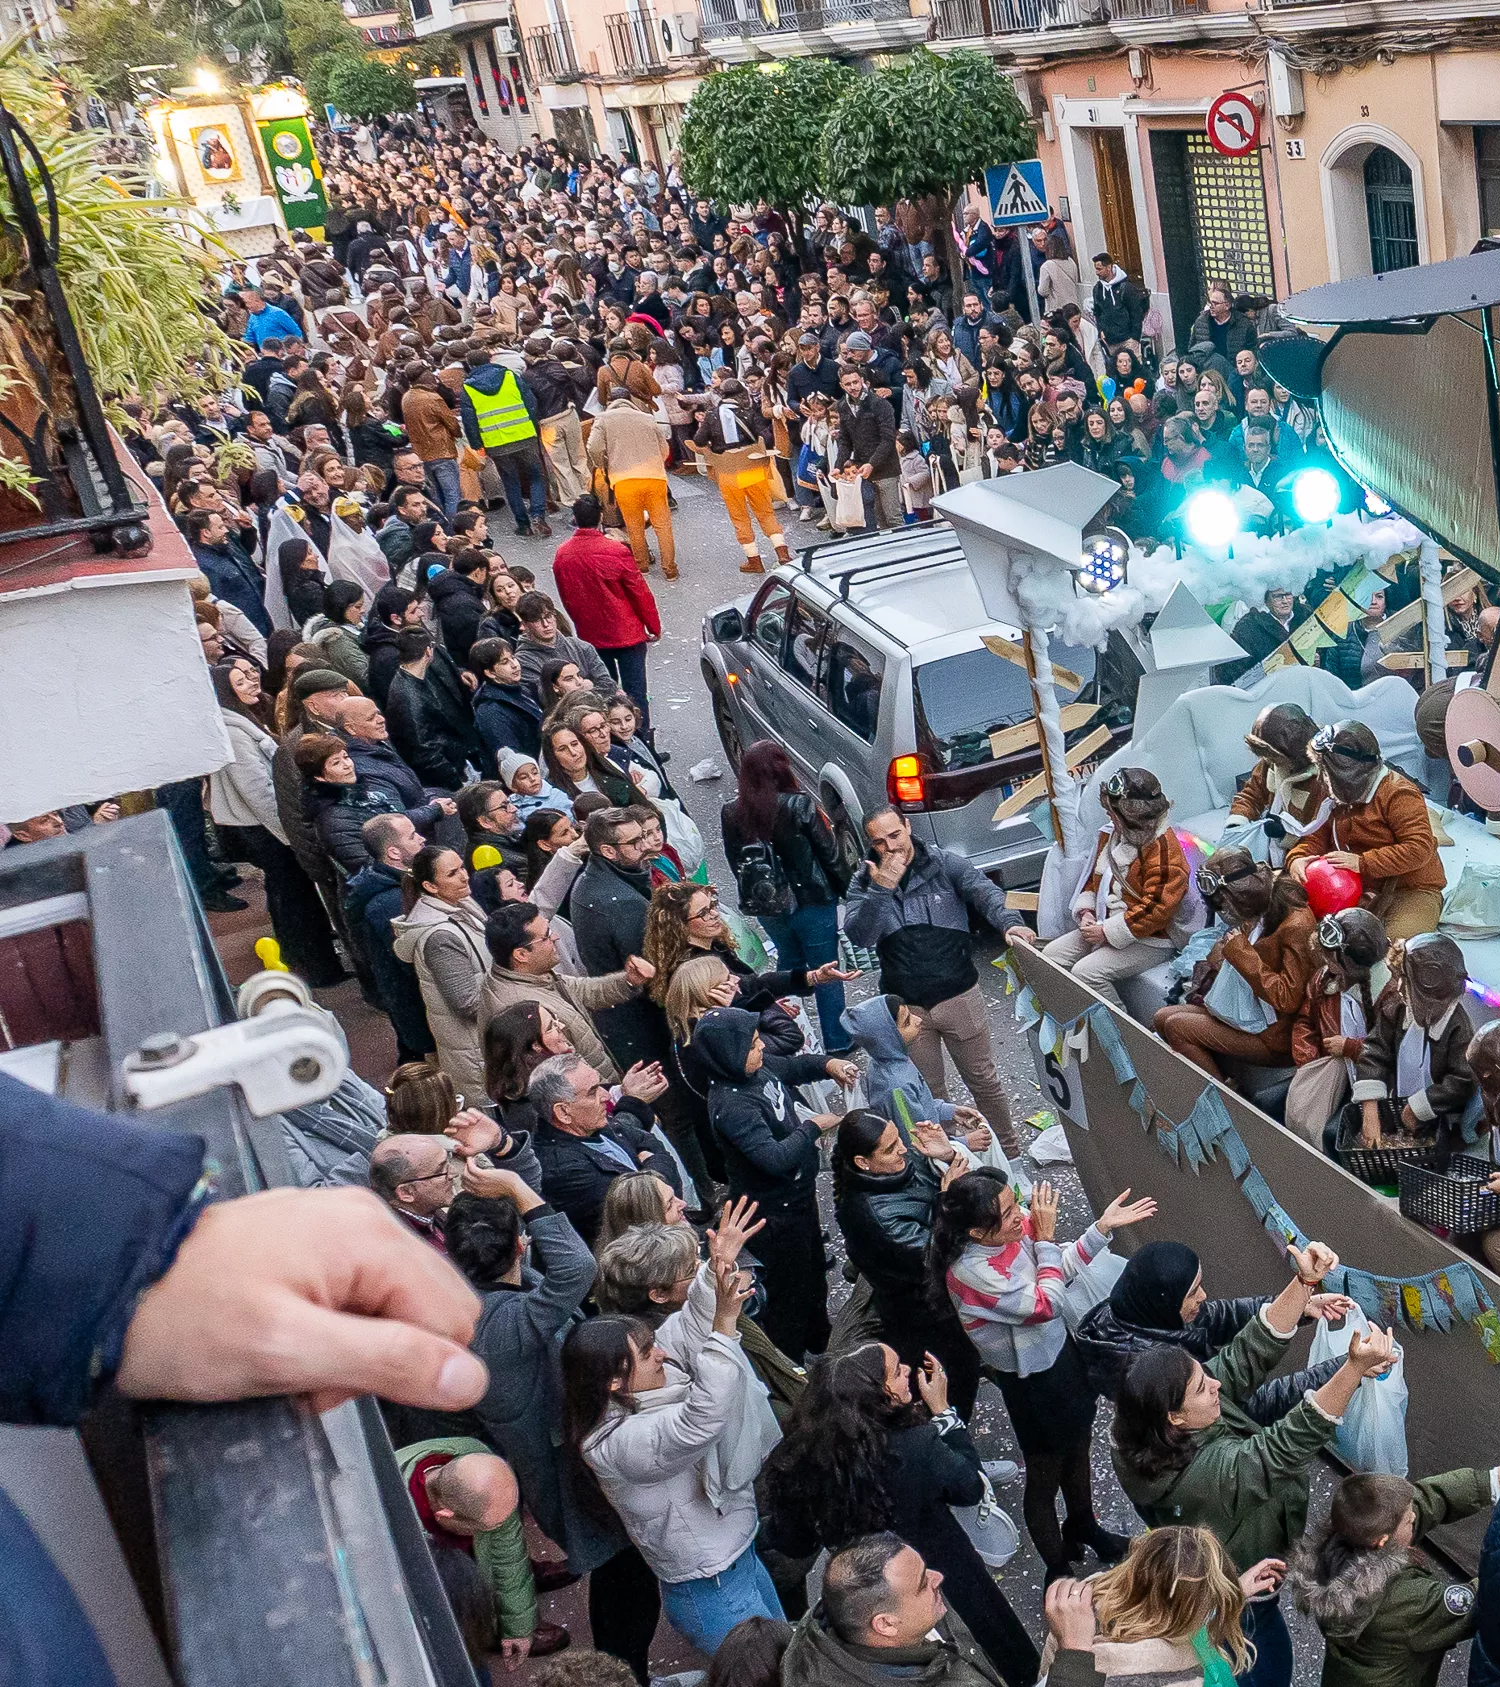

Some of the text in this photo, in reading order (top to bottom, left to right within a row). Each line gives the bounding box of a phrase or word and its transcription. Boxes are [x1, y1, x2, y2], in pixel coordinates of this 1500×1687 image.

[1360, 104, 1370, 118] 33
[1286, 141, 1302, 158] 33
[1044, 1051, 1072, 1111] 5
